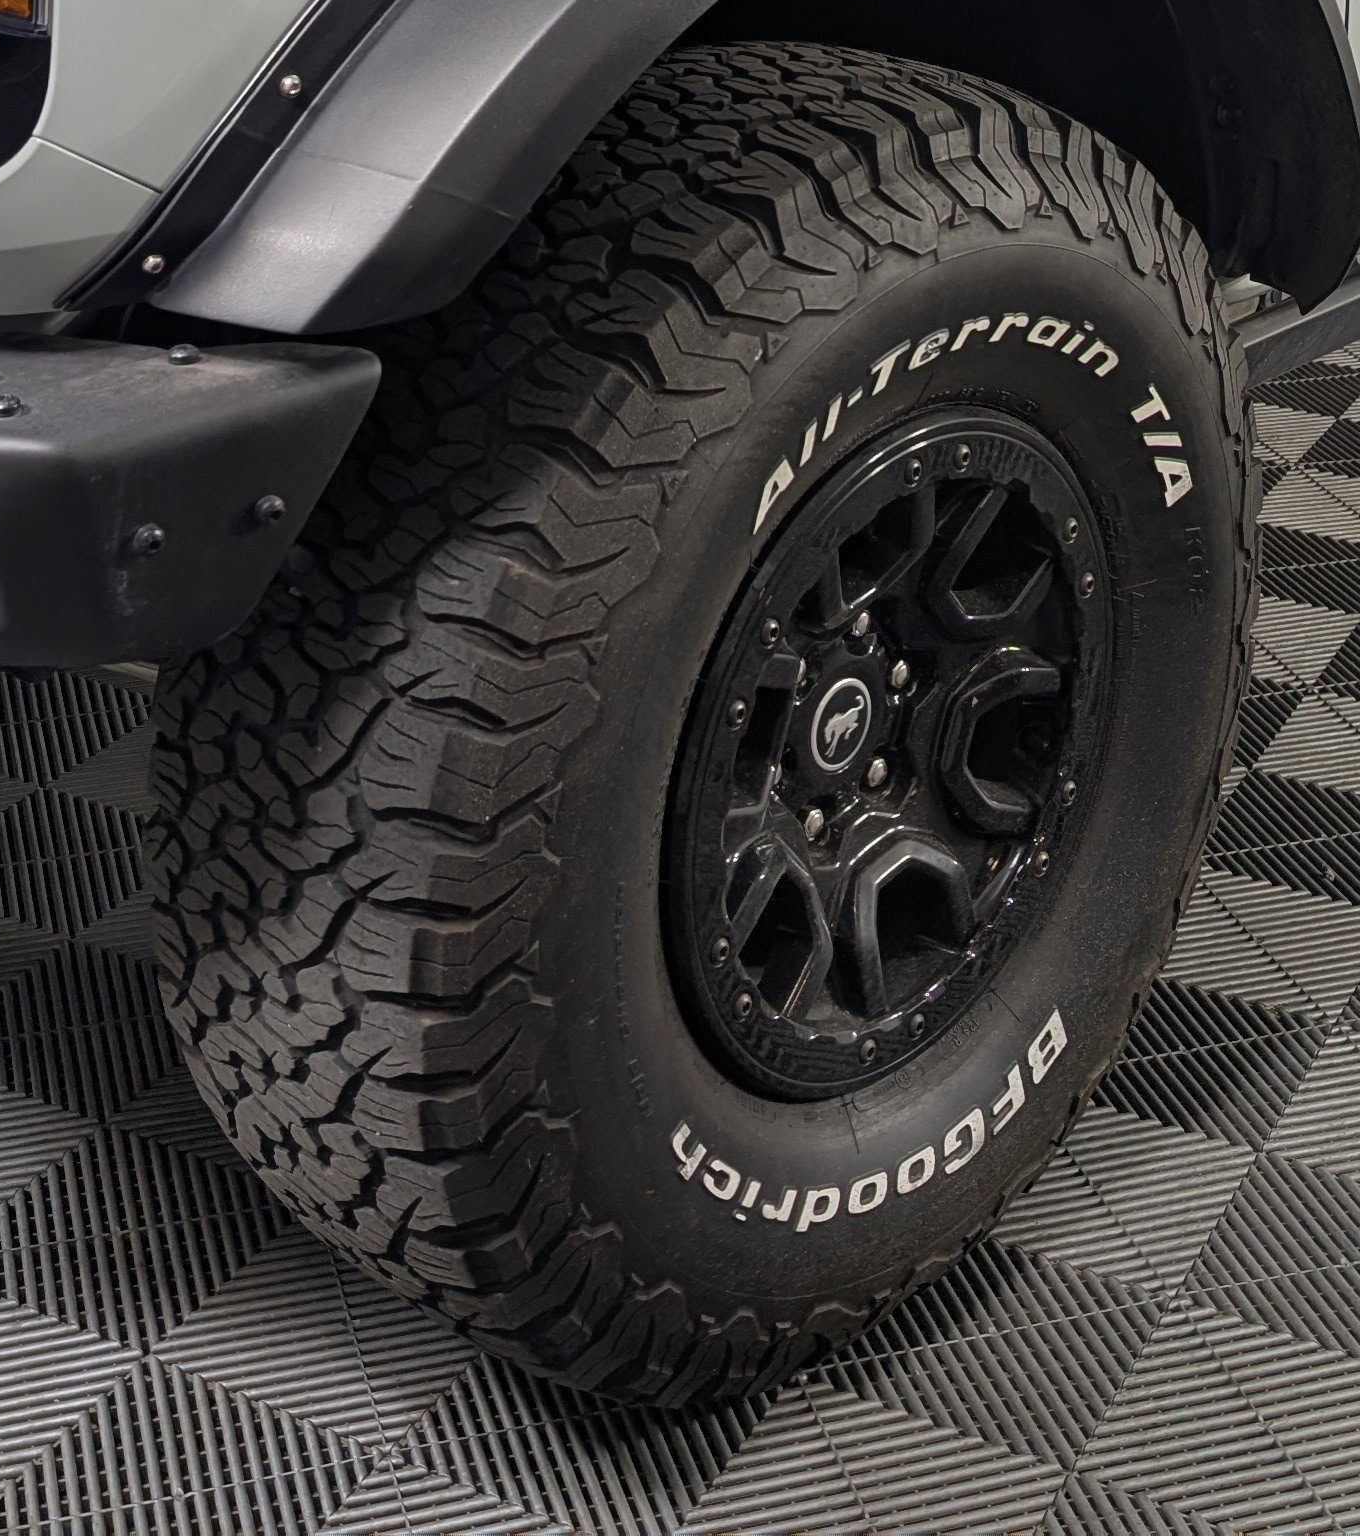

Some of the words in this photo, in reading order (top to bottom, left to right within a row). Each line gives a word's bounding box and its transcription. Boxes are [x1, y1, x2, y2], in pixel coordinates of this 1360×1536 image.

[752, 311, 1120, 536] All-Terrain
[1130, 383, 1194, 508] T/A
[670, 1007, 1068, 1233] BFGoodrich
